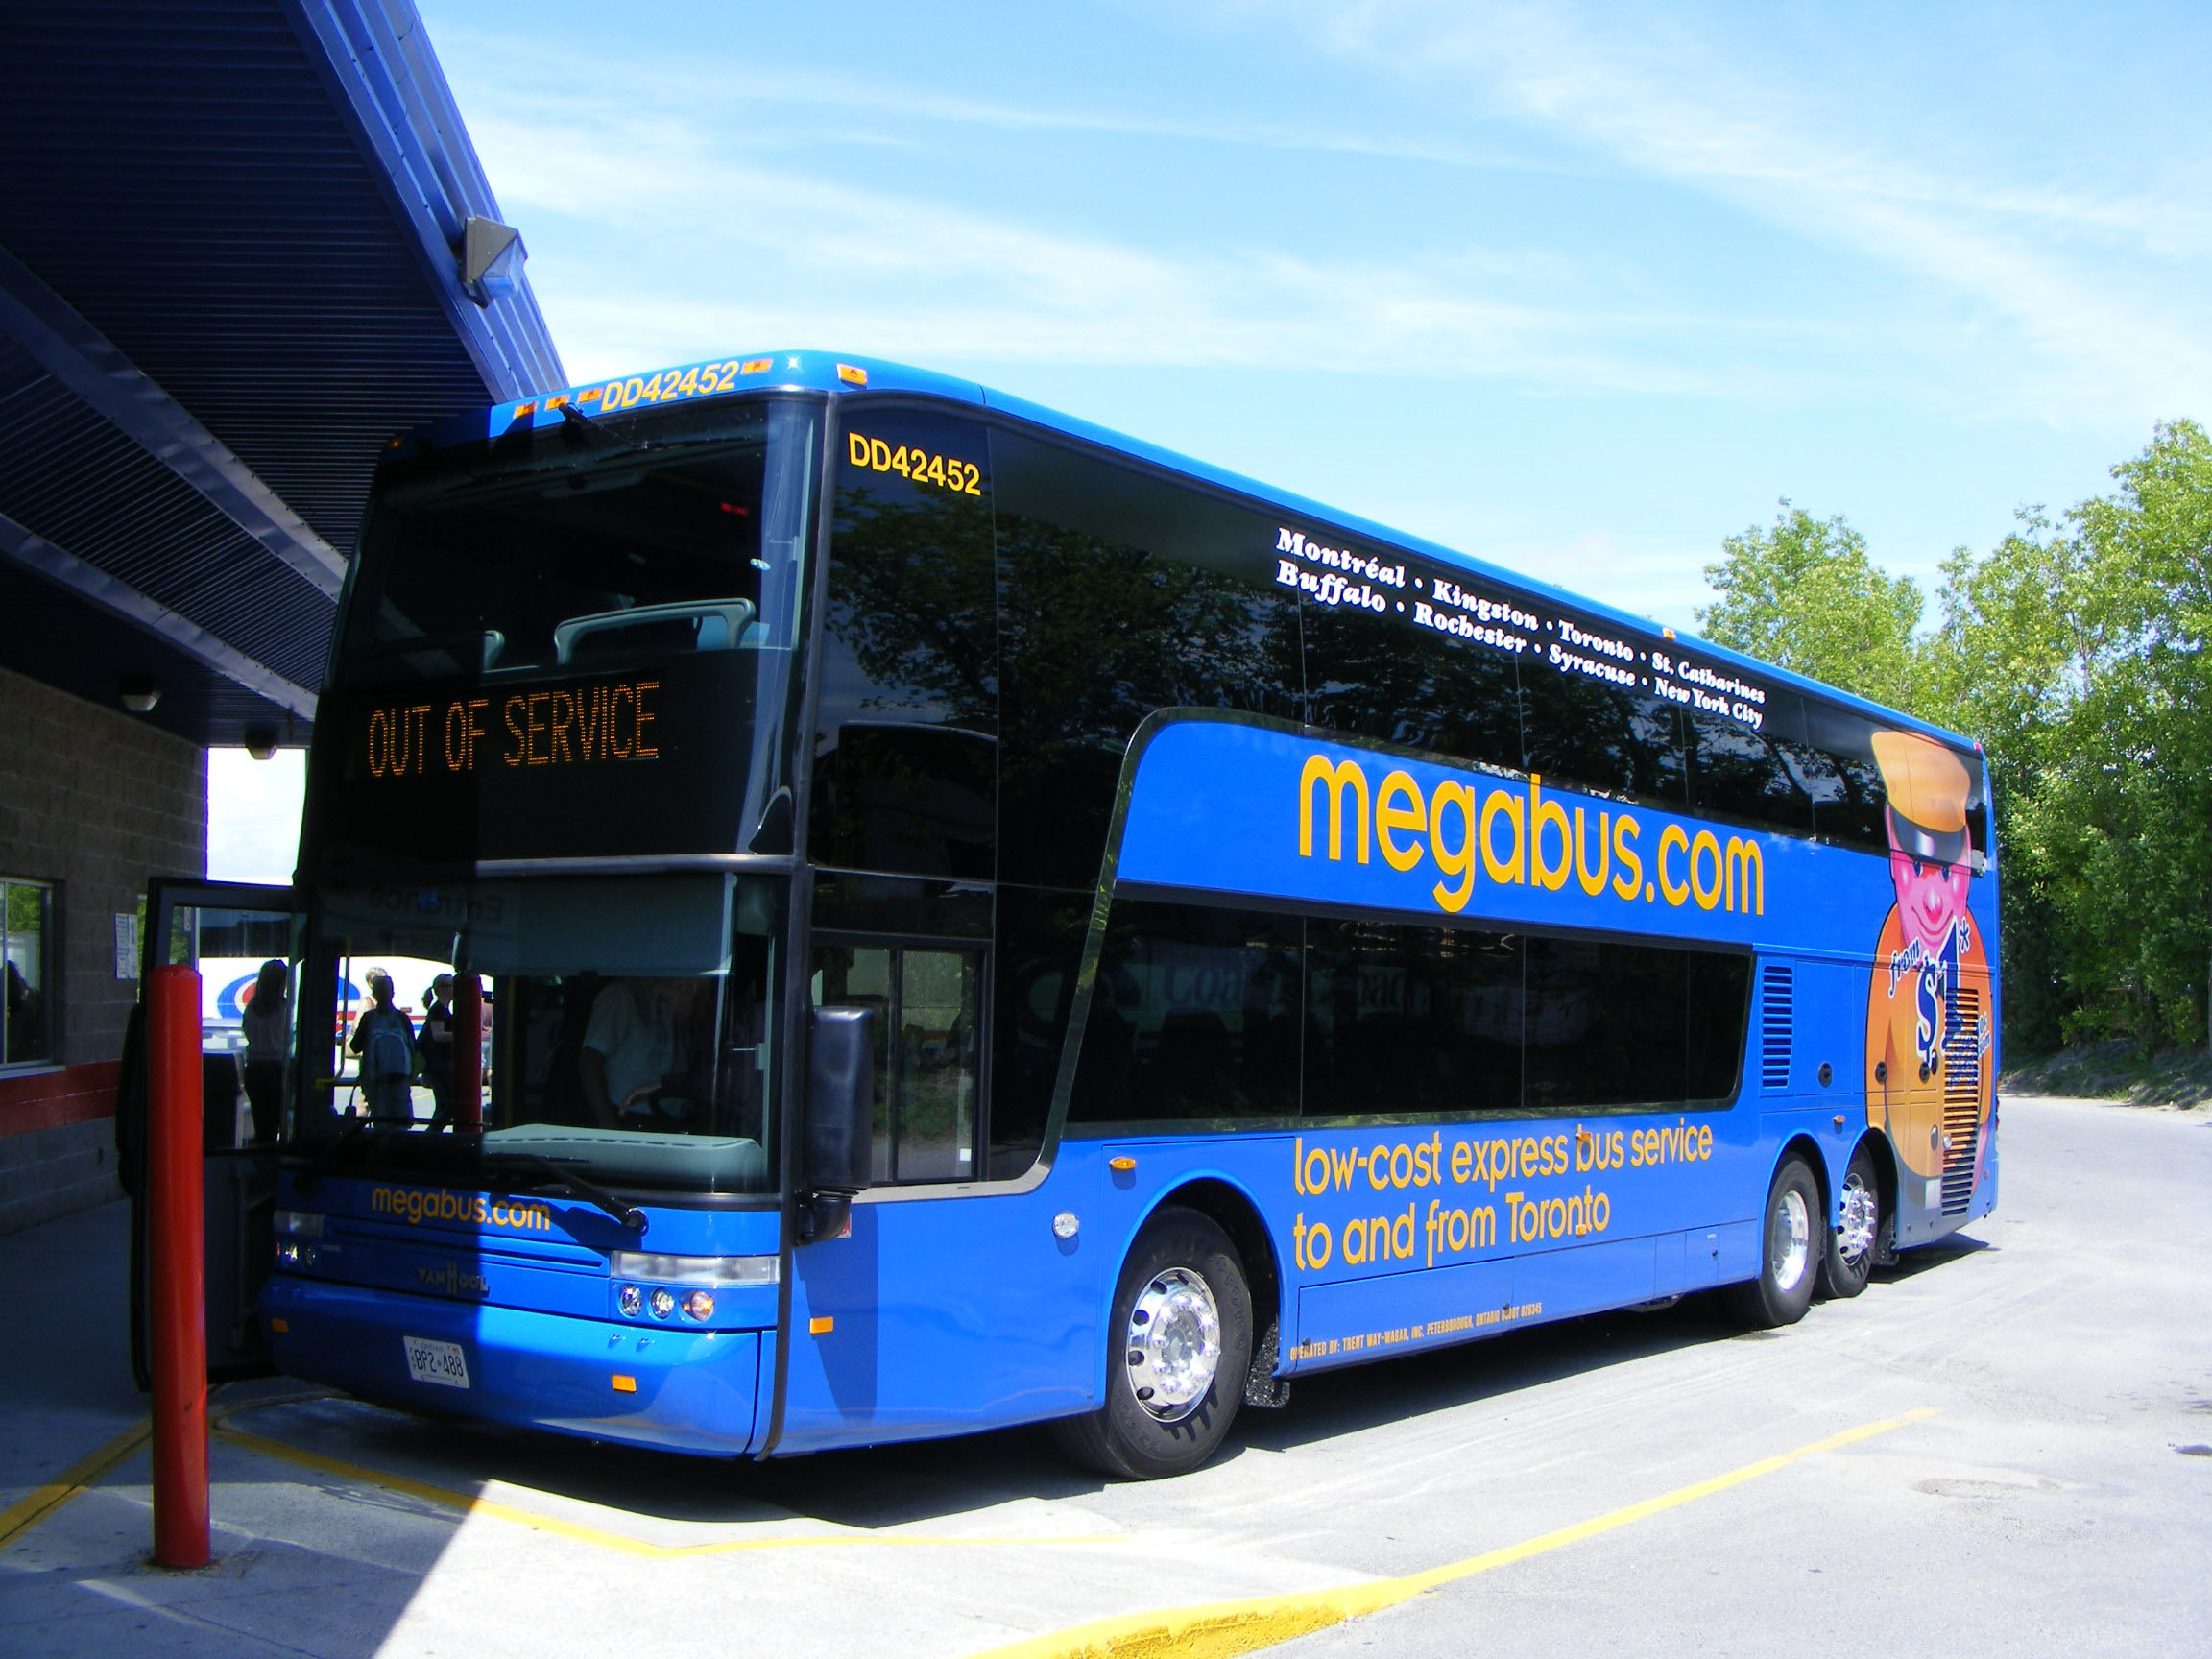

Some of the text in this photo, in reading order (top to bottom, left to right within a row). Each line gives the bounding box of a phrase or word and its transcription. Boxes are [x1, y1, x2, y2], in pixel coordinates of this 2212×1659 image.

[600, 360, 739, 413] DD42452
[848, 431, 981, 496] DD42452
[1275, 527, 1767, 706] Montréal Kingston Toronto St. Catharines
[1275, 559, 1764, 731] Buffalo Rochester Syracuse New York City
[369, 681, 660, 777] OUT OF SERVICE
[1298, 753, 1765, 914] megabus.com
[1888, 937, 1920, 998] from
[1294, 1117, 1713, 1196] low-cost express bus service
[372, 1187, 551, 1230] megabus.com
[1293, 1184, 1611, 1270] to and from Toronto
[1289, 1341, 1327, 1362] OPERATED
[1329, 1339, 1340, 1355] BY:
[1342, 1334, 1365, 1352] TRENT
[1411, 1325, 1424, 1339] INC.
[1475, 1310, 1501, 1327] ONTARIO
